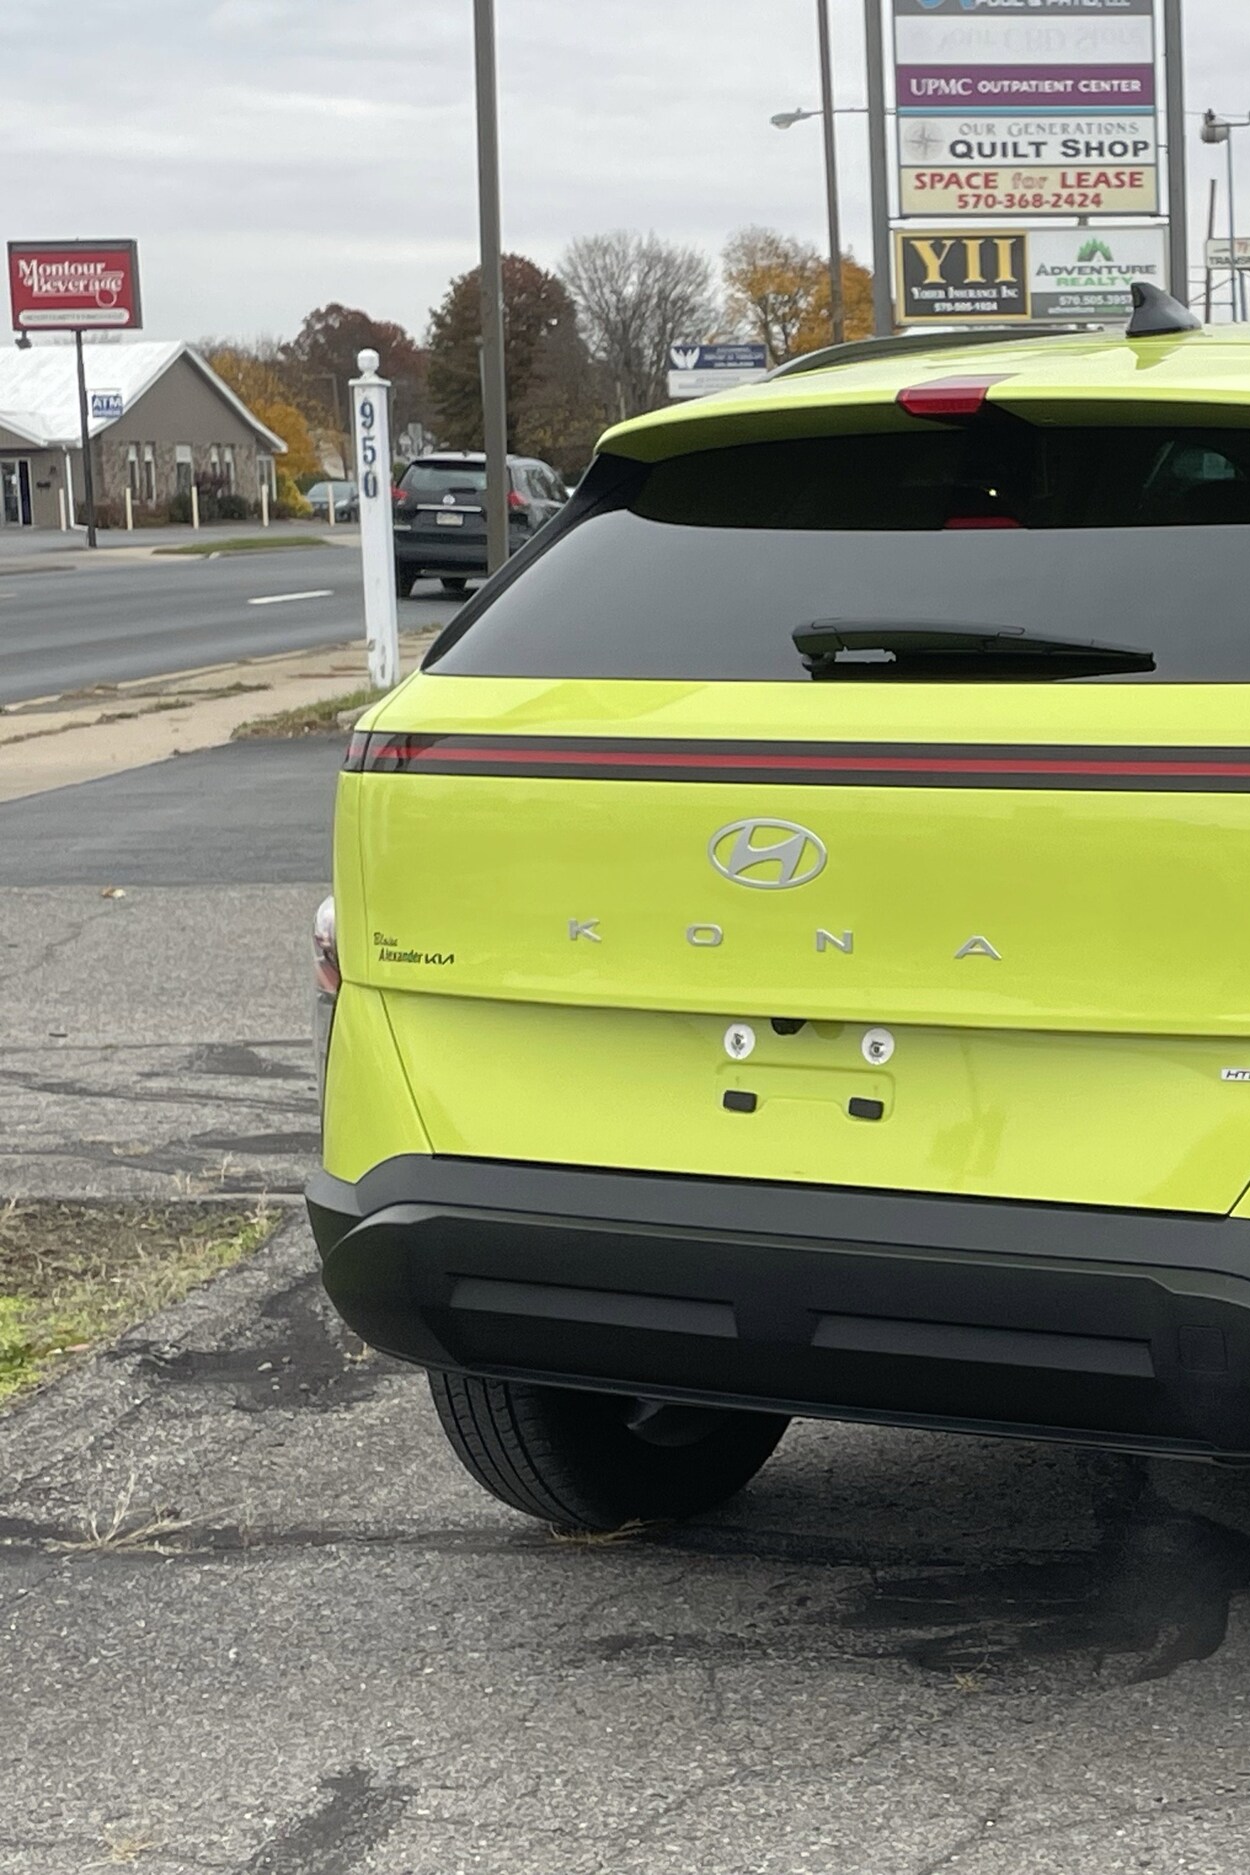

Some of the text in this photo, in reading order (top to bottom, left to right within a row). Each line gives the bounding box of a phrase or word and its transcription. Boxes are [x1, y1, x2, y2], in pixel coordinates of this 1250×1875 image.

[910, 79, 1142, 96] UPMC OUTPATIENT CENTER
[959, 122, 1139, 136] OUR GENERATIONS
[949, 139, 1150, 160] QUILT SHOP
[914, 171, 1144, 190] SPACE for LEASE
[956, 193, 1104, 209] 570-368-2424
[18, 258, 106, 278] Montour
[909, 238, 1018, 284] YII
[1036, 263, 1157, 276] ADVENTURE
[23, 273, 124, 308] Beverage
[1056, 276, 1134, 287] REALTY
[93, 397, 122, 409] ATM
[359, 400, 379, 499] 950
[568, 917, 1002, 961] KONA
[425, 953, 455, 965] KIA
